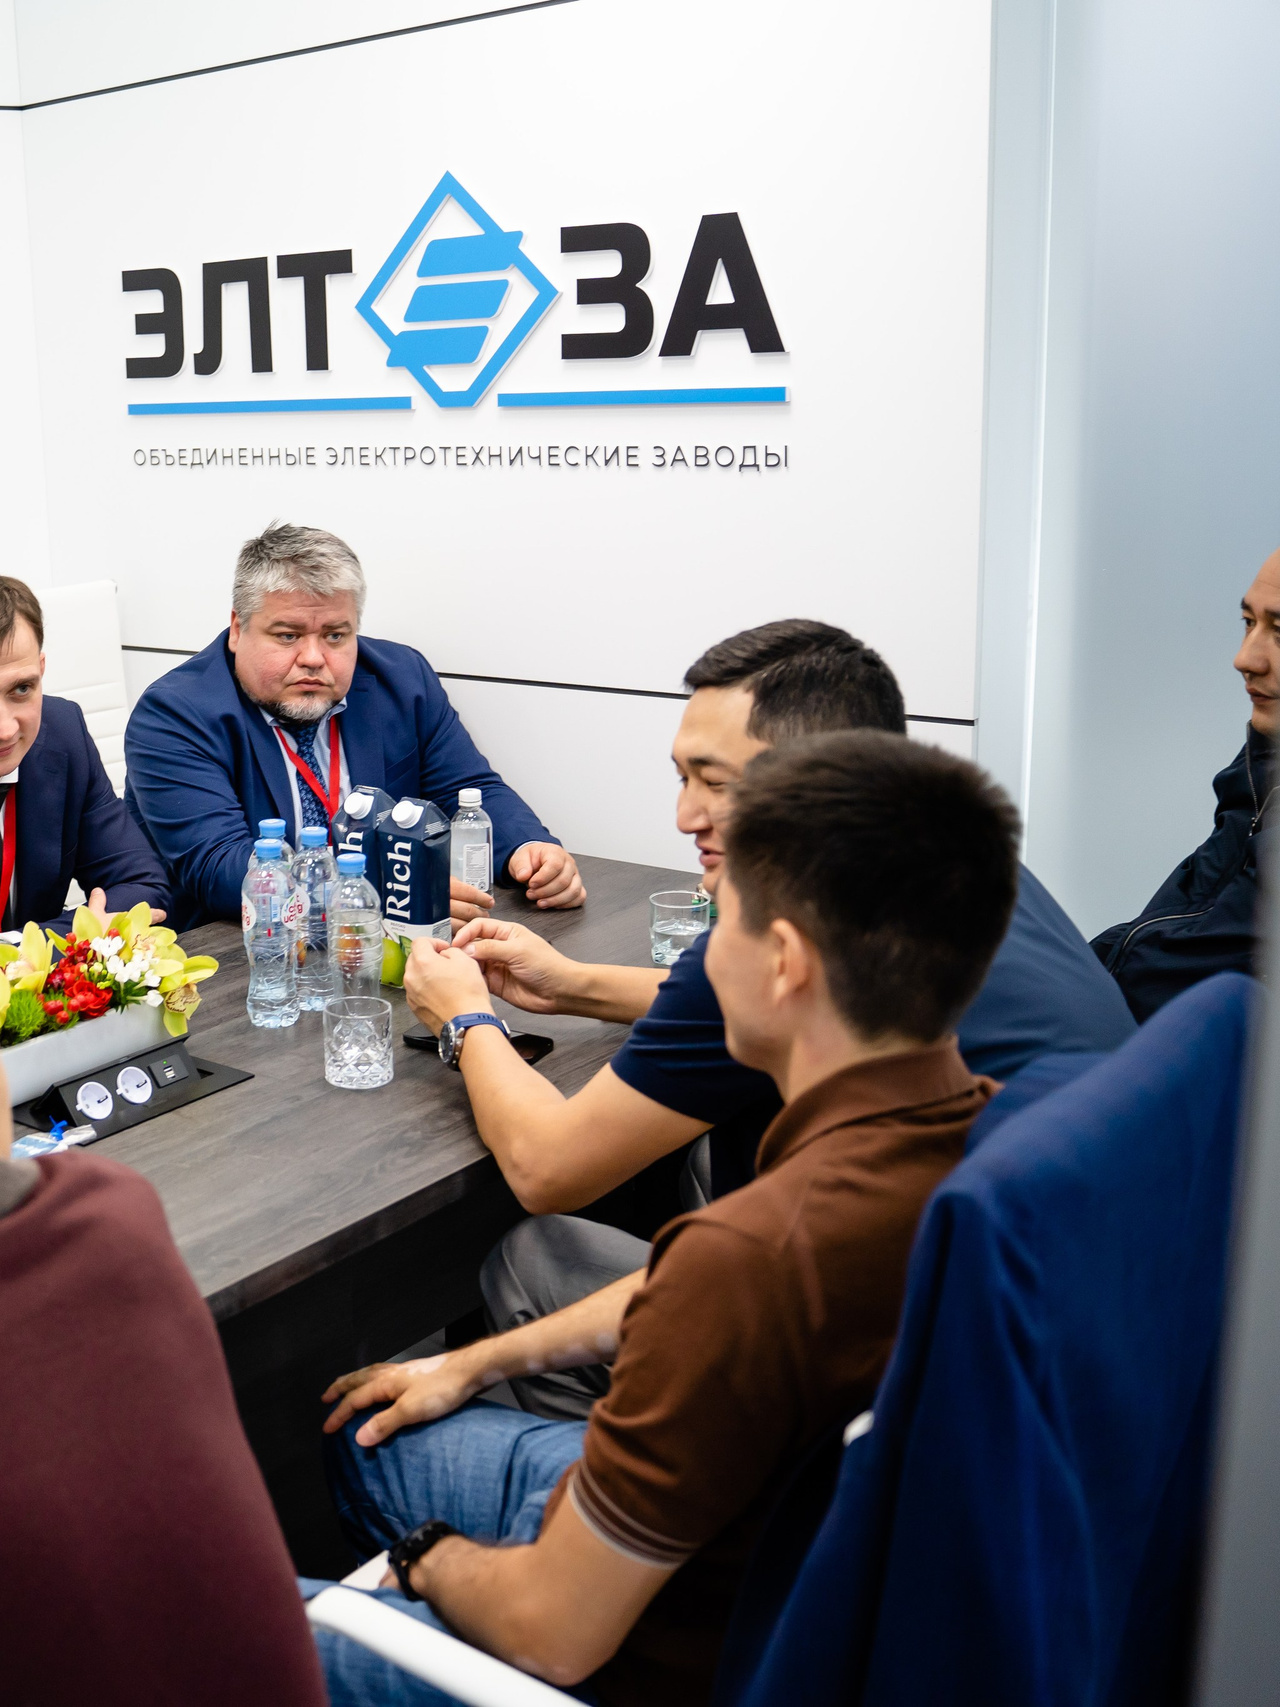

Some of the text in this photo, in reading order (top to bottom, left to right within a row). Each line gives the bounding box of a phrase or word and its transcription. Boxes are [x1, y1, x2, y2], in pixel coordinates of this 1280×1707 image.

[133, 445, 789, 473] ОБЪЕДИНЕННЫЕ ЭЛЕКТРОТЕХНИЧЕСКИЕ ЗАВОДЫ
[386, 841, 412, 920] Rich
